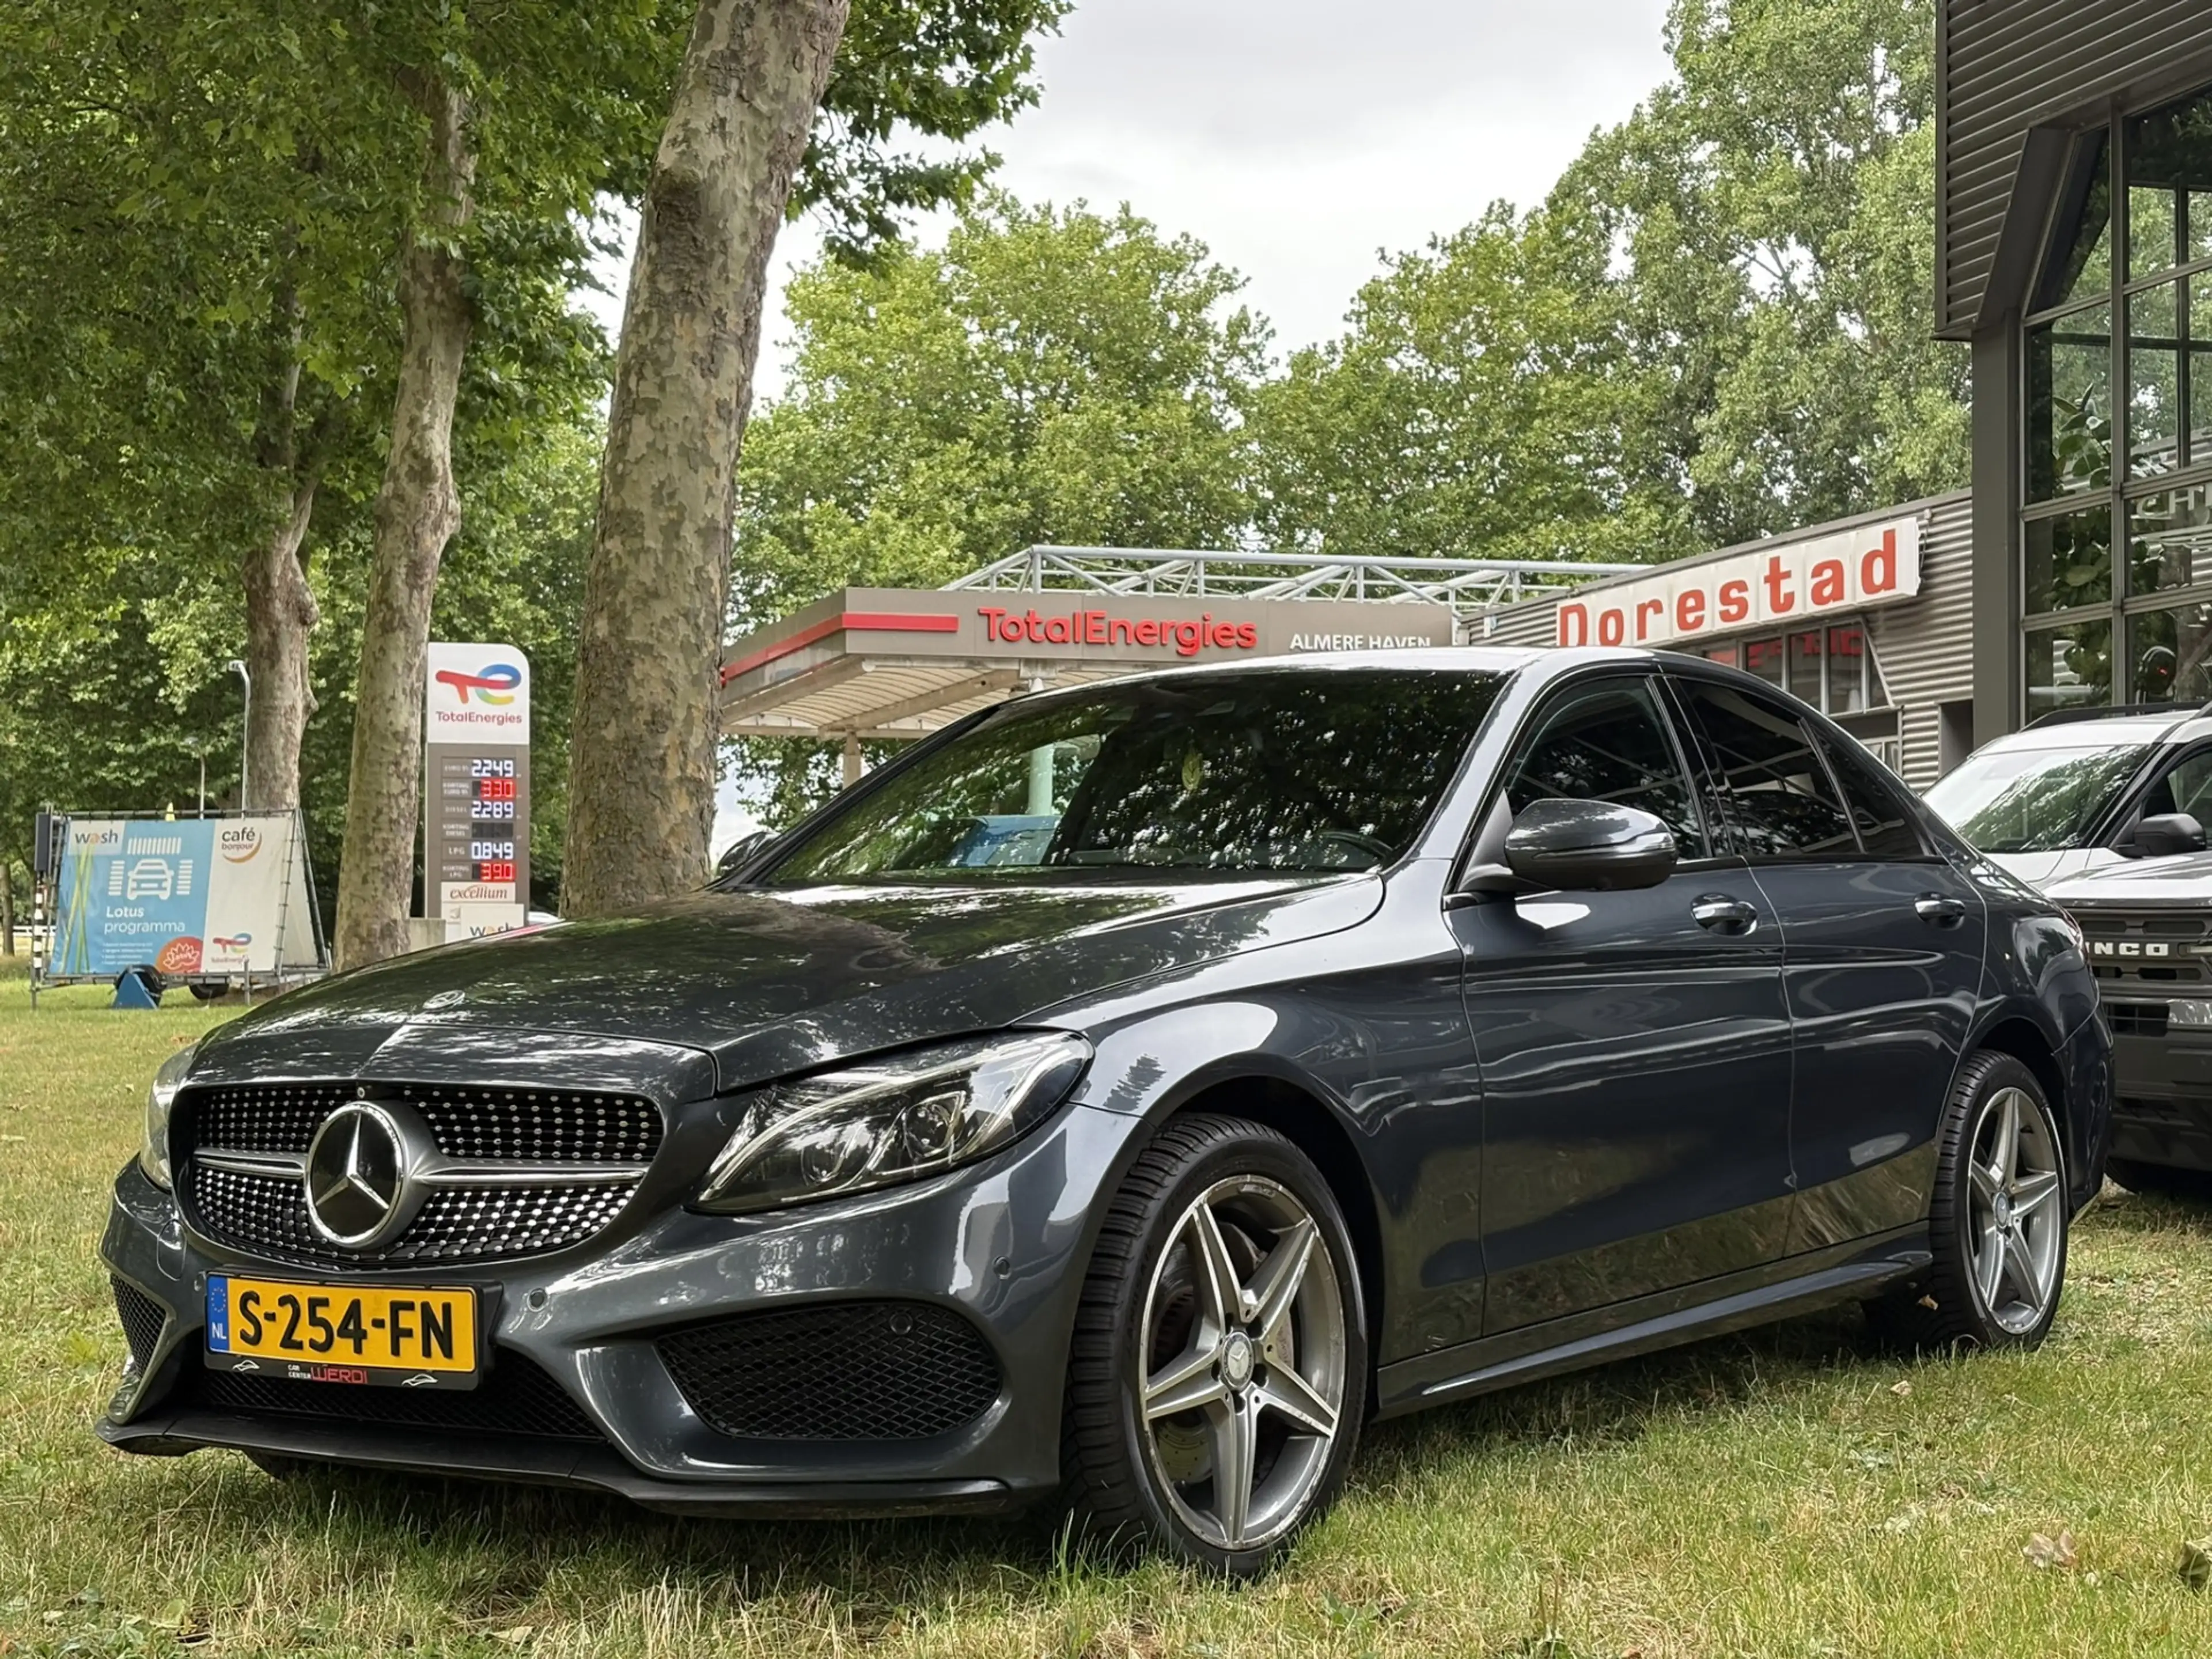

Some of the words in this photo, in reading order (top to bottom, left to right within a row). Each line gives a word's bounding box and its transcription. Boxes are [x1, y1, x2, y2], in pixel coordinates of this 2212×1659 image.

[1560, 528, 1896, 646] Dorestad
[978, 607, 1258, 656] TotalEnergies
[1290, 634, 1364, 650] ALMERE
[1369, 635, 1431, 649] HAVEN
[435, 711, 522, 726] TotalEnergies
[75, 828, 119, 845] wash
[221, 827, 256, 842] café
[221, 843, 253, 851] bonjour
[448, 846, 465, 855] LPG
[450, 884, 508, 900] excellium
[106, 906, 145, 918] Lotus
[104, 921, 185, 935] programma
[2085, 941, 2169, 957] NCO
[211, 1321, 227, 1340] NL
[238, 1290, 454, 1359] S-254-FN
[311, 1366, 368, 1384] WERDI
